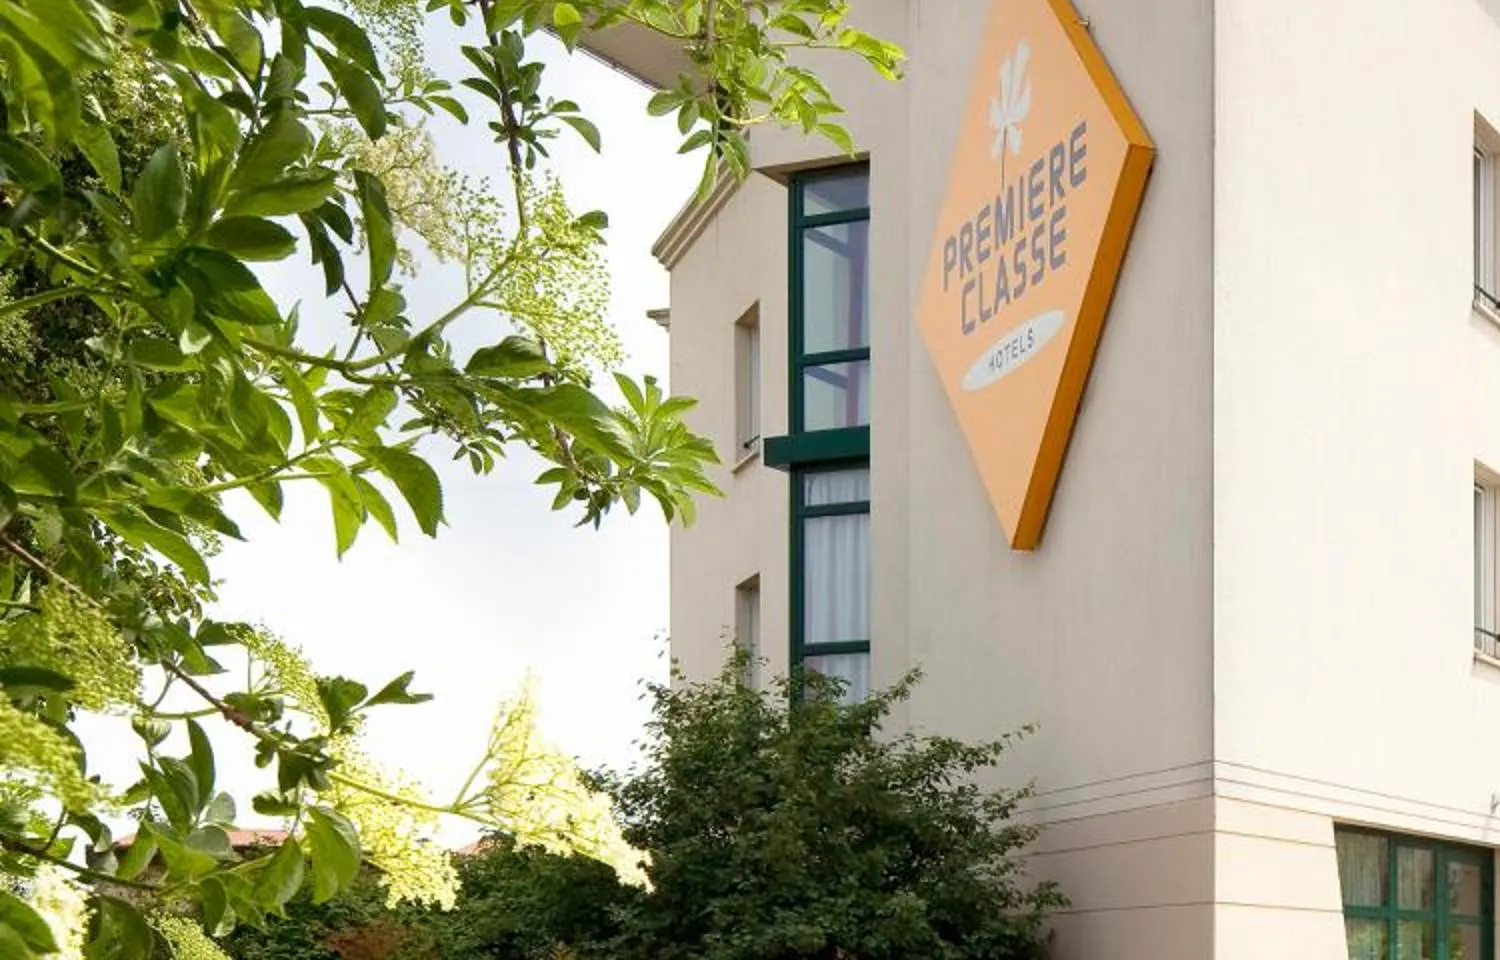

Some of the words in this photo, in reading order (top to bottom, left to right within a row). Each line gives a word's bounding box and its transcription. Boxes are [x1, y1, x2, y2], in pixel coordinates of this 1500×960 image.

[942, 121, 1088, 291] PREMIERE
[961, 207, 1068, 335] CLASSE
[988, 327, 1035, 372] HOTELS
